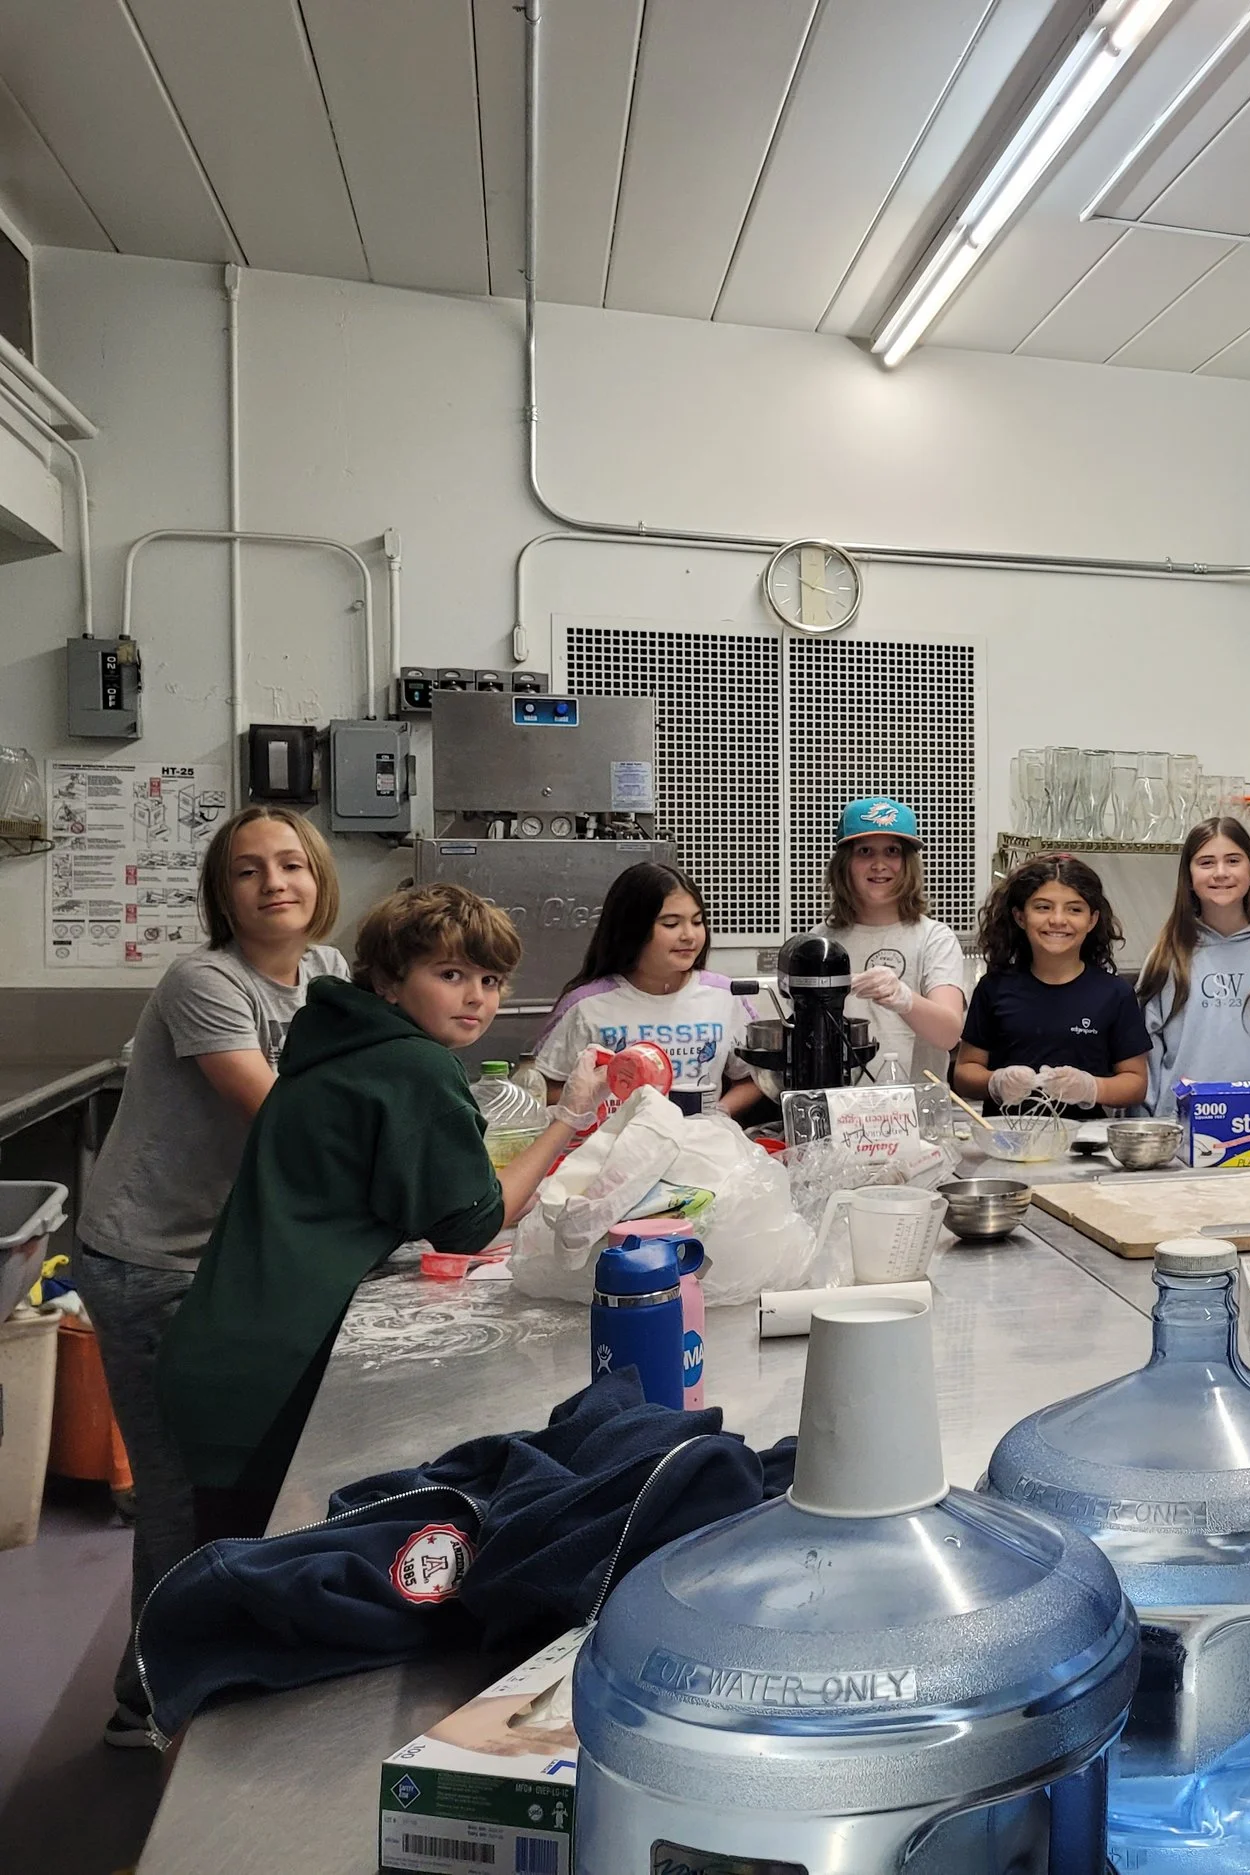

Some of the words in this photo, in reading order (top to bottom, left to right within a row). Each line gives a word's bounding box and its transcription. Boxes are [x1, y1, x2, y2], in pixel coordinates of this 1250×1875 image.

[106, 656, 117, 670] ON
[161, 766, 195, 776] HT-25
[600, 1022, 723, 1046] BLESSED
[1194, 1103, 1227, 1116] 3000
[403, 1558, 417, 1587] 1885
[708, 1667, 803, 1707] WATER
[821, 1669, 909, 1706] ONLY
